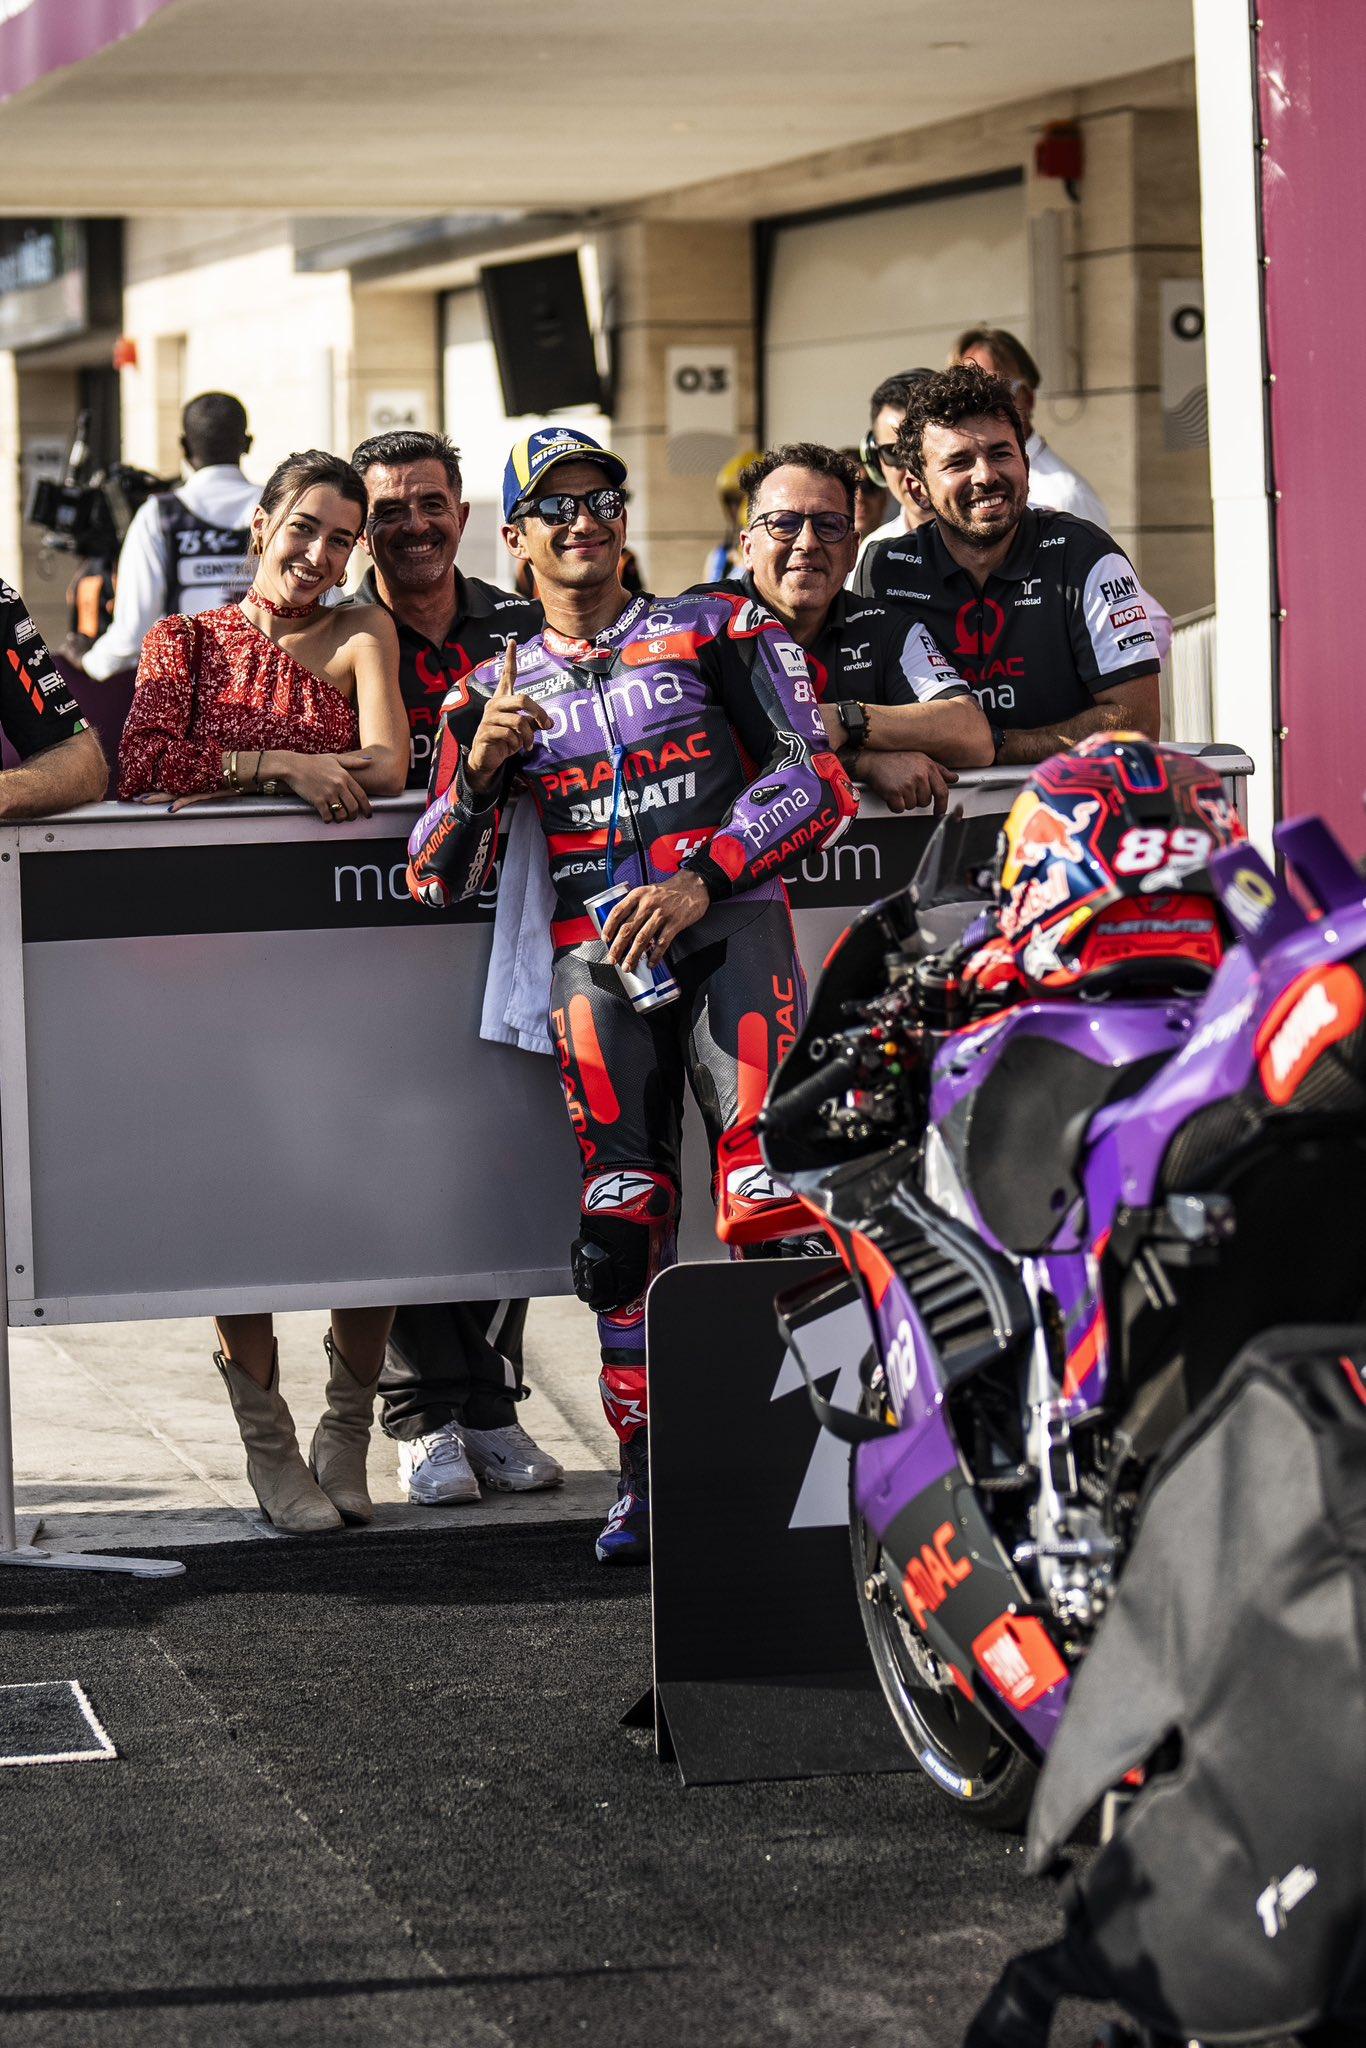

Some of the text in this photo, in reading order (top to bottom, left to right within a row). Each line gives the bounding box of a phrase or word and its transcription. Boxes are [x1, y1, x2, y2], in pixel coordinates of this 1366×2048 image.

[673, 364, 728, 395] 03
[531, 443, 582, 468] MICHEL
[637, 626, 682, 640] PRAMAC
[494, 645, 544, 680] FMM
[843, 659, 873, 671] randstad
[541, 671, 683, 753] prima
[539, 731, 712, 800] PRAMAC
[568, 771, 696, 826] DUCATI
[743, 787, 810, 849] prima
[751, 807, 836, 879] PRAMAC
[1112, 826, 1213, 875] 89
[771, 975, 800, 1066] MAC
[551, 1007, 606, 1170] PRAMA
